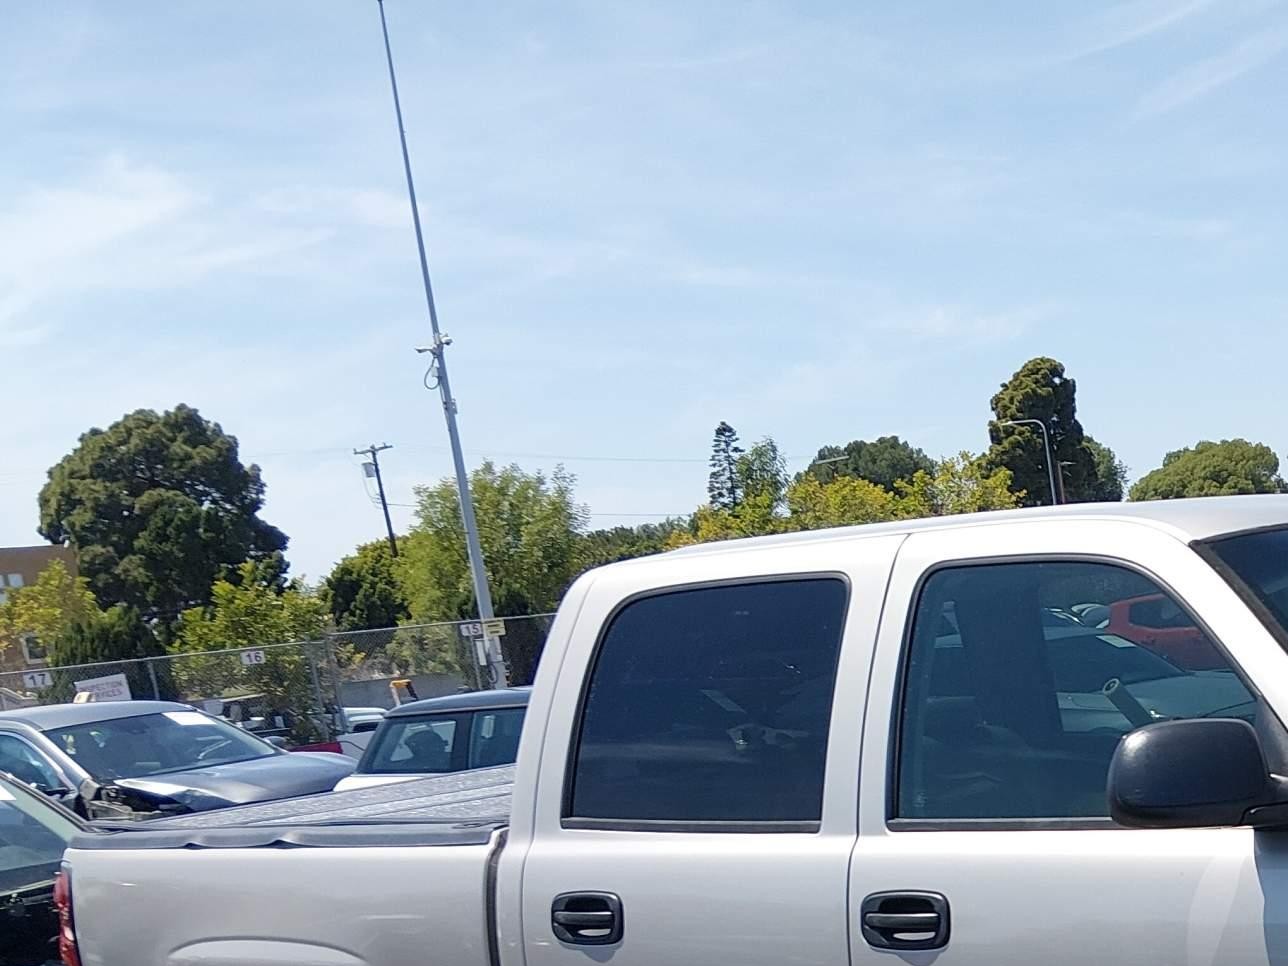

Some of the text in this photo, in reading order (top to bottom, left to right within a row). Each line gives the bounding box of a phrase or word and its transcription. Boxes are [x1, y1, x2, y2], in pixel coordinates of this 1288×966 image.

[465, 623, 480, 635] 15
[246, 651, 262, 663] 16
[29, 673, 46, 686] 17
